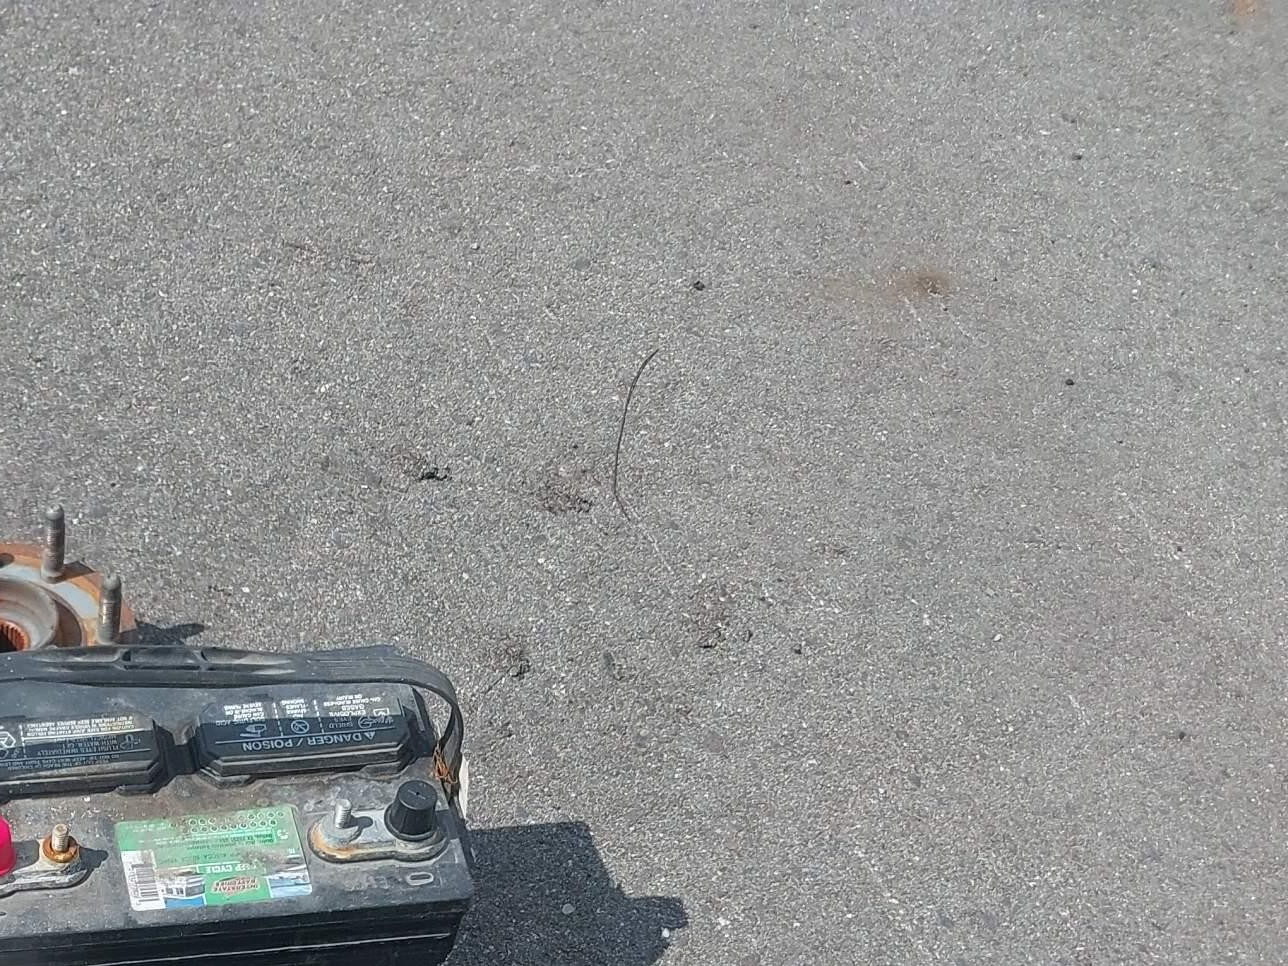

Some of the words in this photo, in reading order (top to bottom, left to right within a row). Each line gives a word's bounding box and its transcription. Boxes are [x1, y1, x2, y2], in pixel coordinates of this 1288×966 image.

[307, 732, 362, 746] DANGER
[242, 740, 294, 751] POISON
[206, 865, 232, 873] CYCLE
